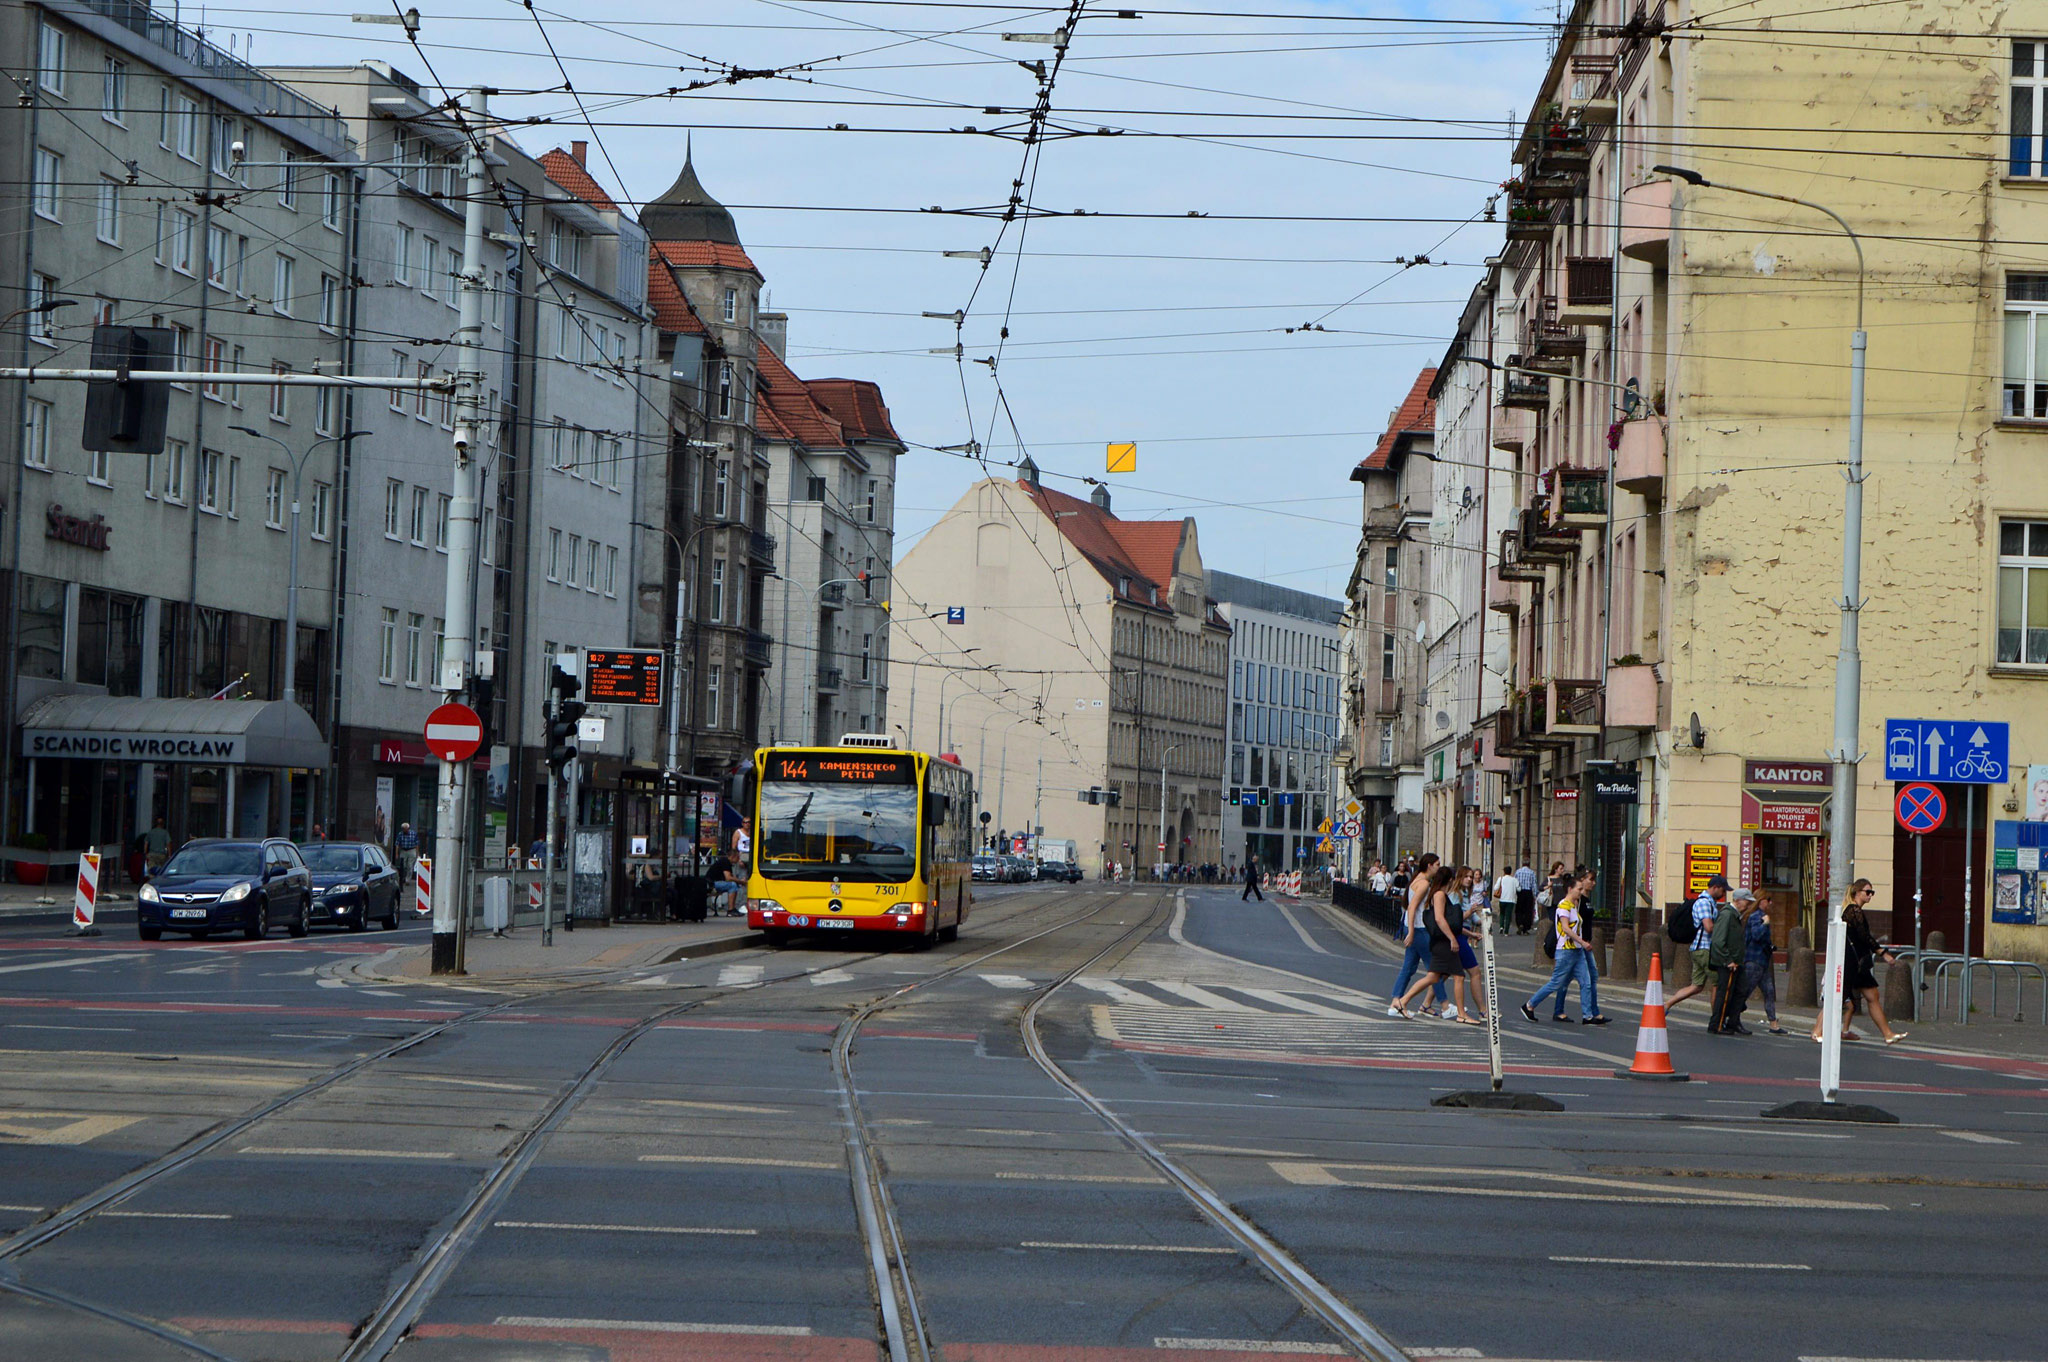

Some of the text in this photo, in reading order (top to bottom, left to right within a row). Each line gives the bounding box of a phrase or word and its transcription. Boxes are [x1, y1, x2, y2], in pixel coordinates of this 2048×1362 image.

[46, 504, 112, 551] Scandic
[33, 736, 234, 757] SCANDIC WROCŁAW
[387, 748, 401, 762] M
[781, 760, 896, 778] 144 KAMIEŃSKIEGO
[841, 771, 875, 779] PĘTLA
[1754, 768, 1823, 782] KANTOR
[1596, 783, 1611, 792] Pan
[1765, 820, 1774, 828] 71
[1777, 821, 1791, 829] 341
[1807, 822, 1816, 830] 45
[1741, 839, 1750, 886] EXCHANG
[875, 885, 899, 896] 7301
